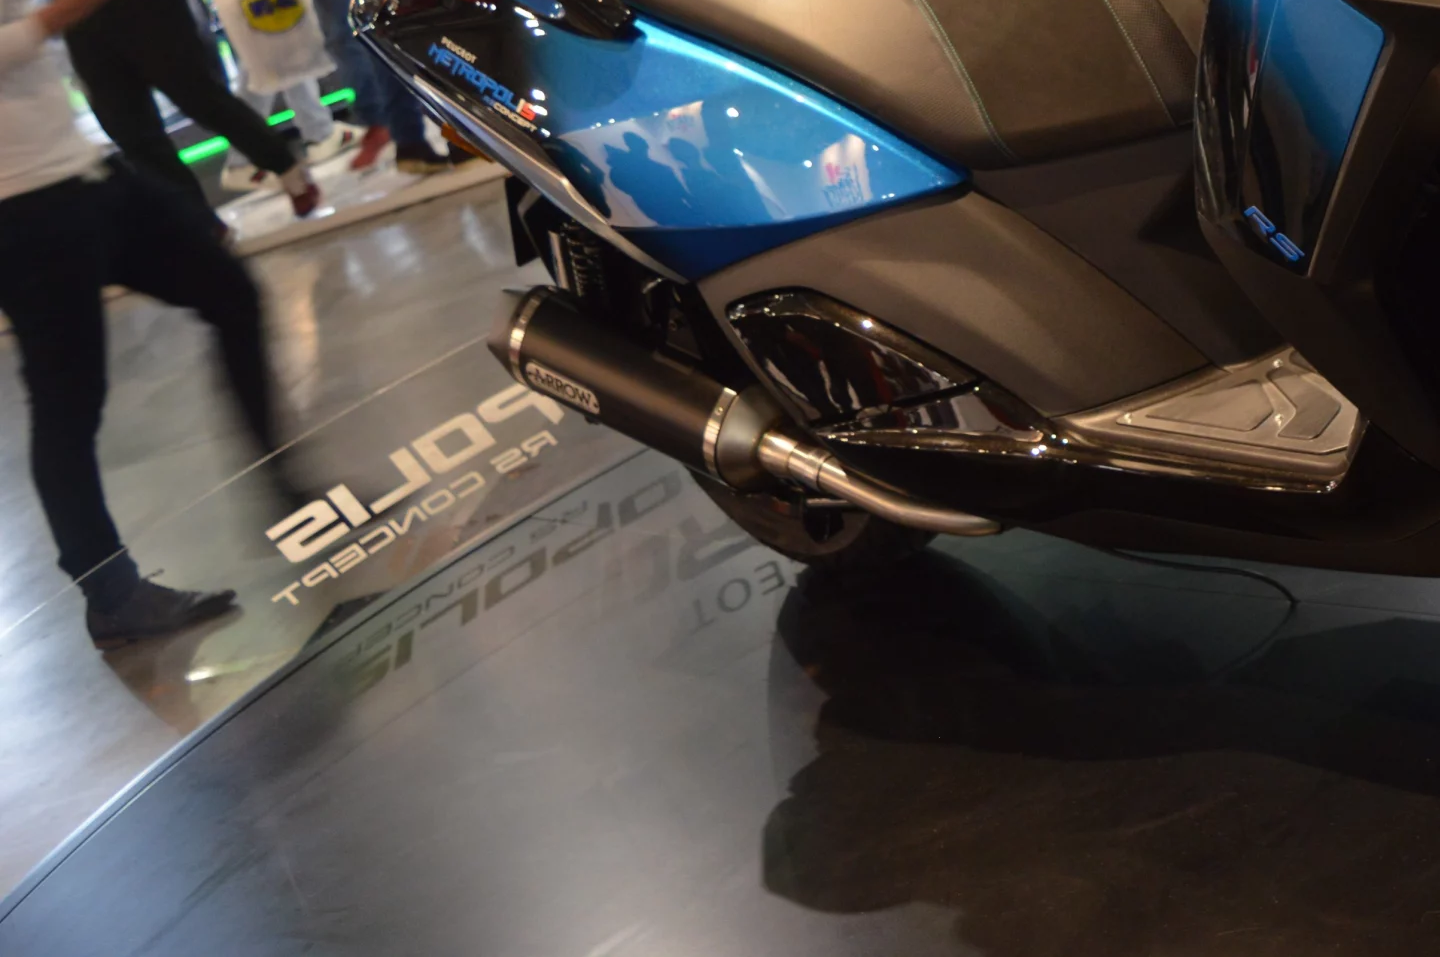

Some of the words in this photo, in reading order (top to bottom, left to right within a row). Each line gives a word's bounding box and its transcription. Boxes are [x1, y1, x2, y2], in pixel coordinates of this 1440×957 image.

[428, 43, 537, 121] METROPOLIS
[1243, 205, 1305, 261] RS
[531, 367, 593, 405] ARROW
